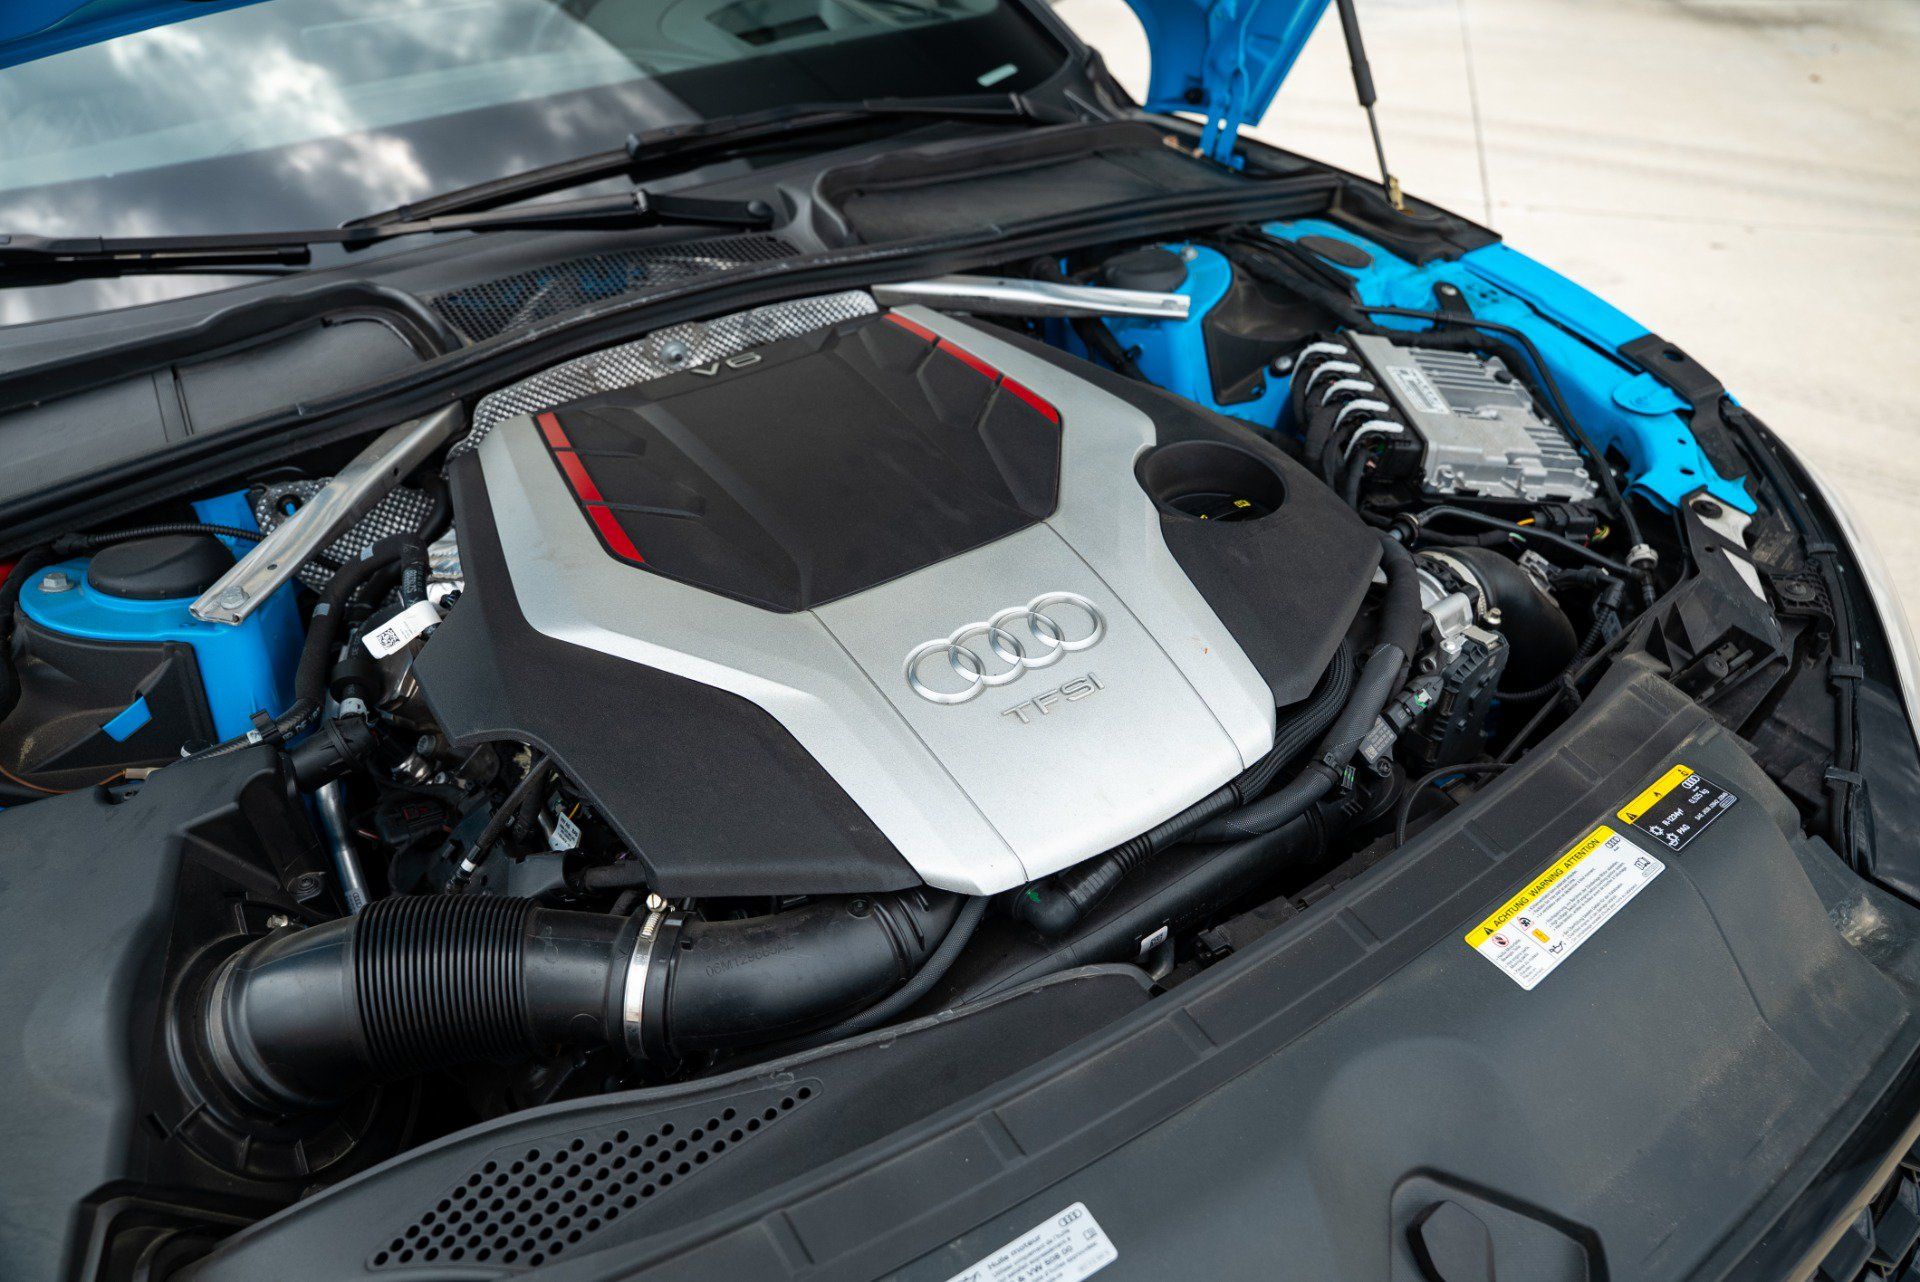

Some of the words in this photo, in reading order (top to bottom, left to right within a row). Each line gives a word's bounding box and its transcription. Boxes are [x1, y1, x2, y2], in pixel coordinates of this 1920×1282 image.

[1000, 671, 1106, 725] TFSI
[1493, 896, 1529, 928] ACHTUNG
[1529, 867, 1564, 897] WARNING
[1563, 837, 1600, 869] ATTENTION
[1010, 1233, 1042, 1256] moteur
